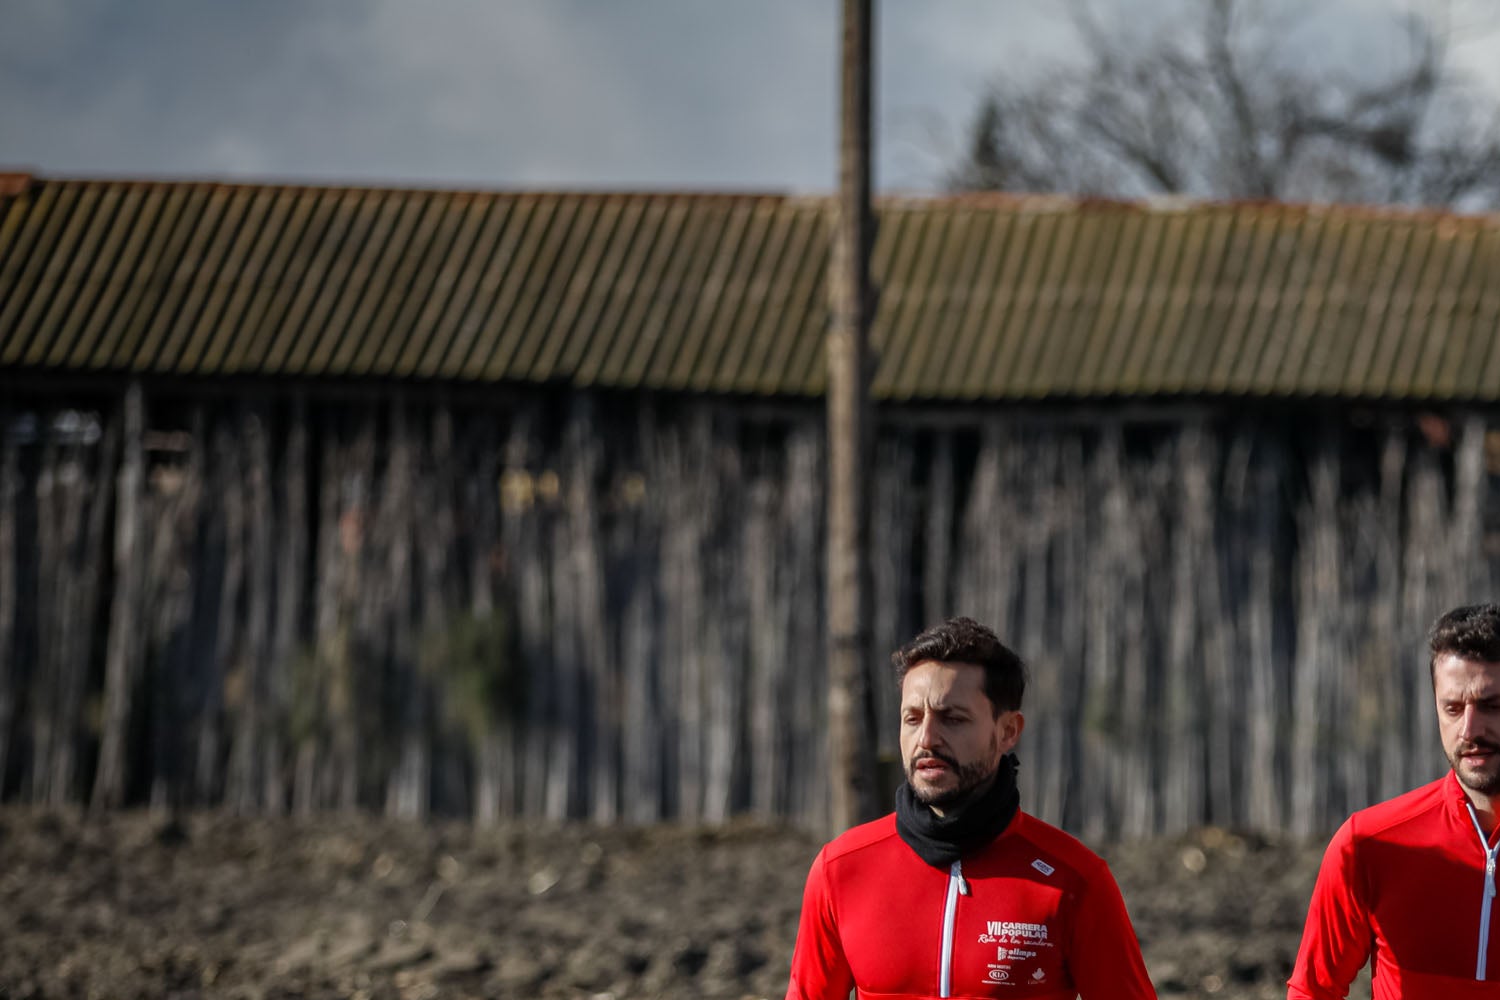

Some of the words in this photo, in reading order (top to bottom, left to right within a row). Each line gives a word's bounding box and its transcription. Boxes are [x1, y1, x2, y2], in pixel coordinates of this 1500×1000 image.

[987, 921, 1001, 936] VII
[1002, 922, 1047, 932] CARRERA
[1002, 930, 1047, 939] POPULAR
